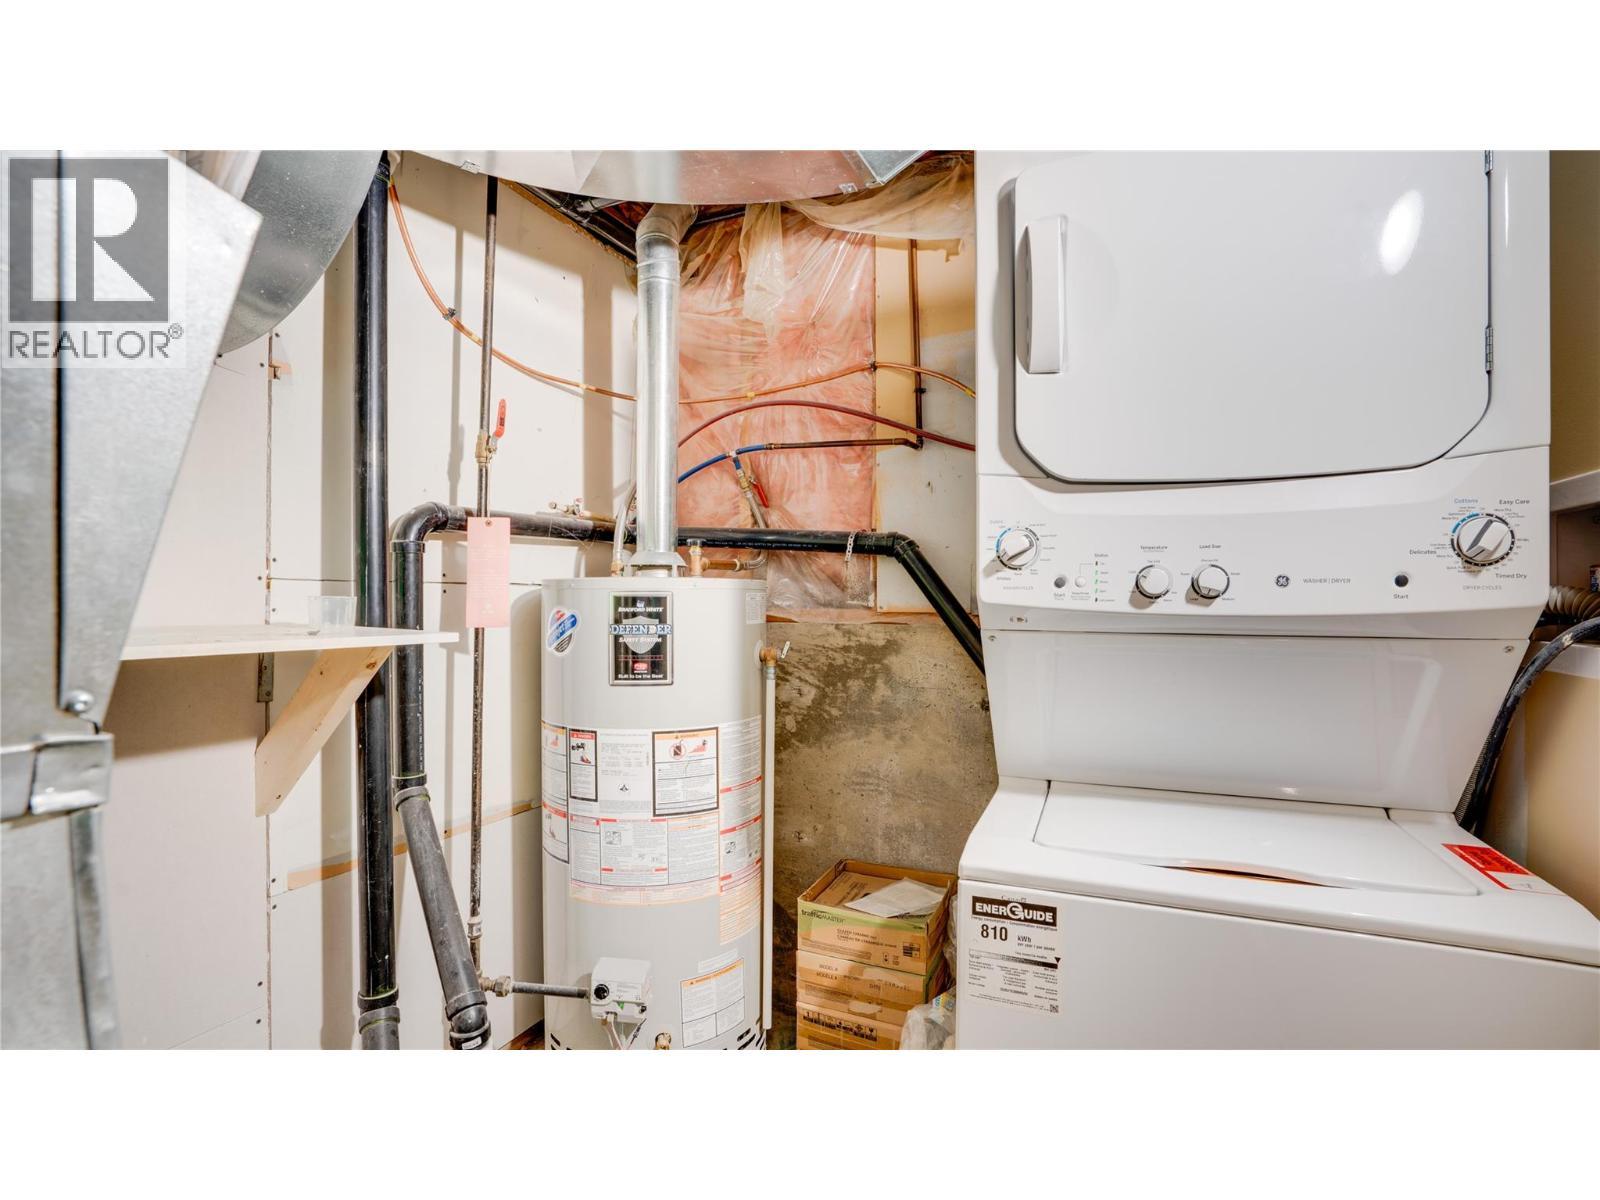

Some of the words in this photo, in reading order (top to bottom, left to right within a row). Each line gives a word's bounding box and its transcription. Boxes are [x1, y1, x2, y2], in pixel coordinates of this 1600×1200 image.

[610, 624, 673, 635] DEFENDER
[975, 902, 1054, 923] ENERGUIDE
[981, 923, 1008, 941] 810
[1017, 935, 1032, 943] kWh
